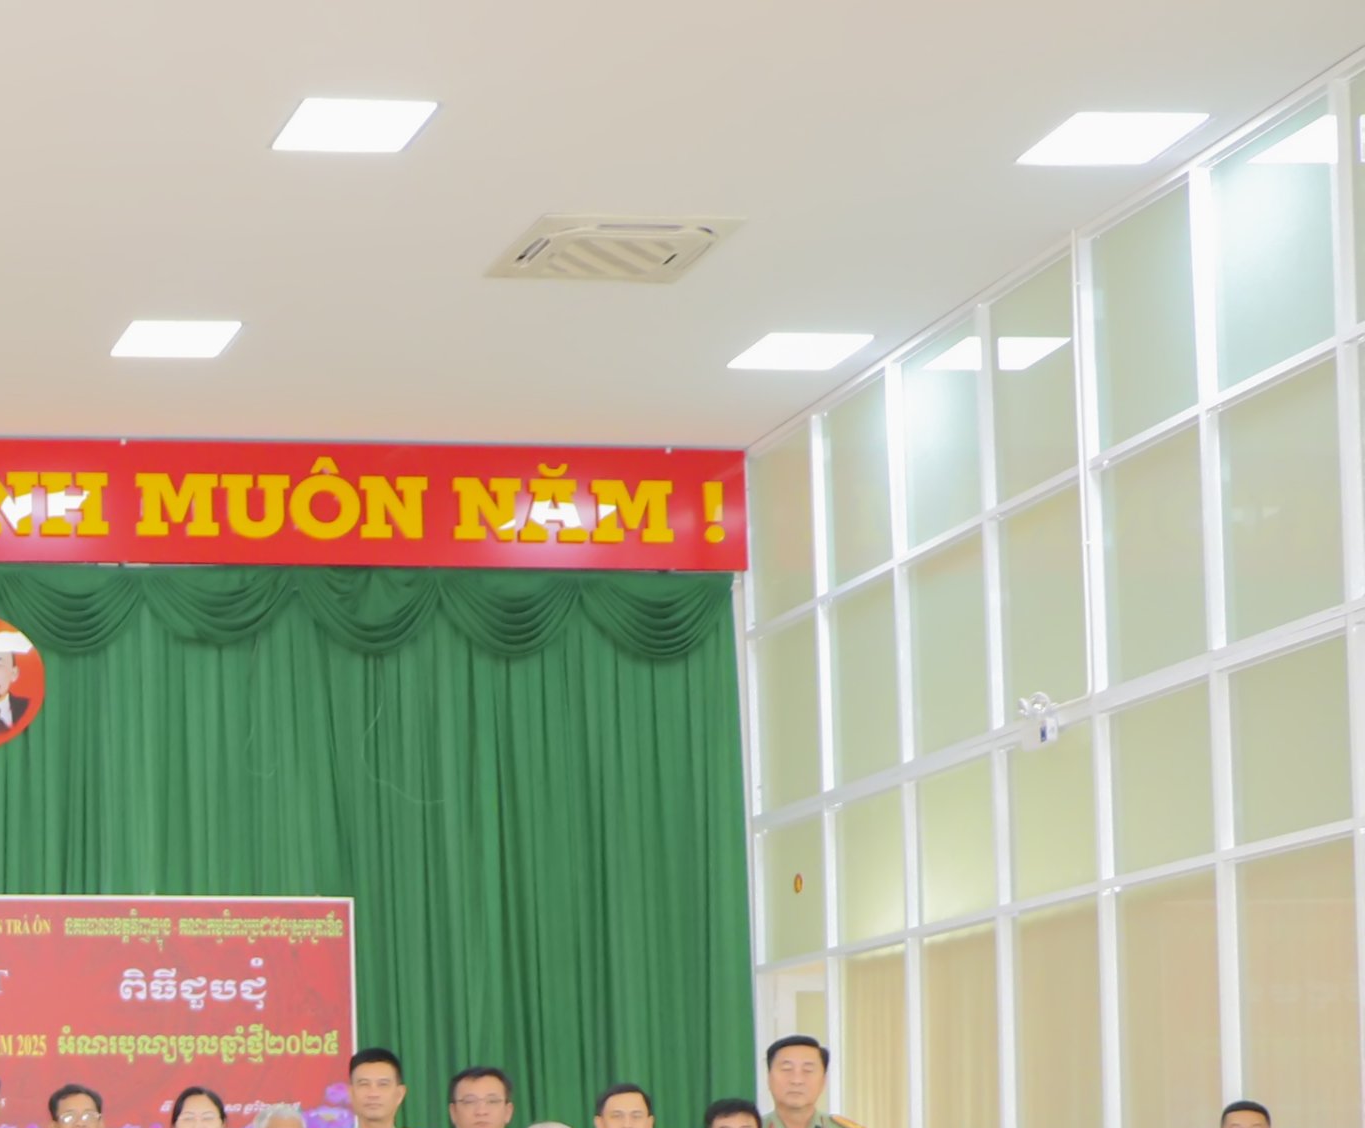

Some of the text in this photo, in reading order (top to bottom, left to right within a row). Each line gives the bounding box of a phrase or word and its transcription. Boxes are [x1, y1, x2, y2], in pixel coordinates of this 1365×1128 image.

[135, 457, 428, 539] MUÔN
[453, 463, 674, 543] NĂM
[703, 482, 725, 543] !
[33, 914, 51, 935] ÔN
[16, 1034, 48, 1057] 2025
